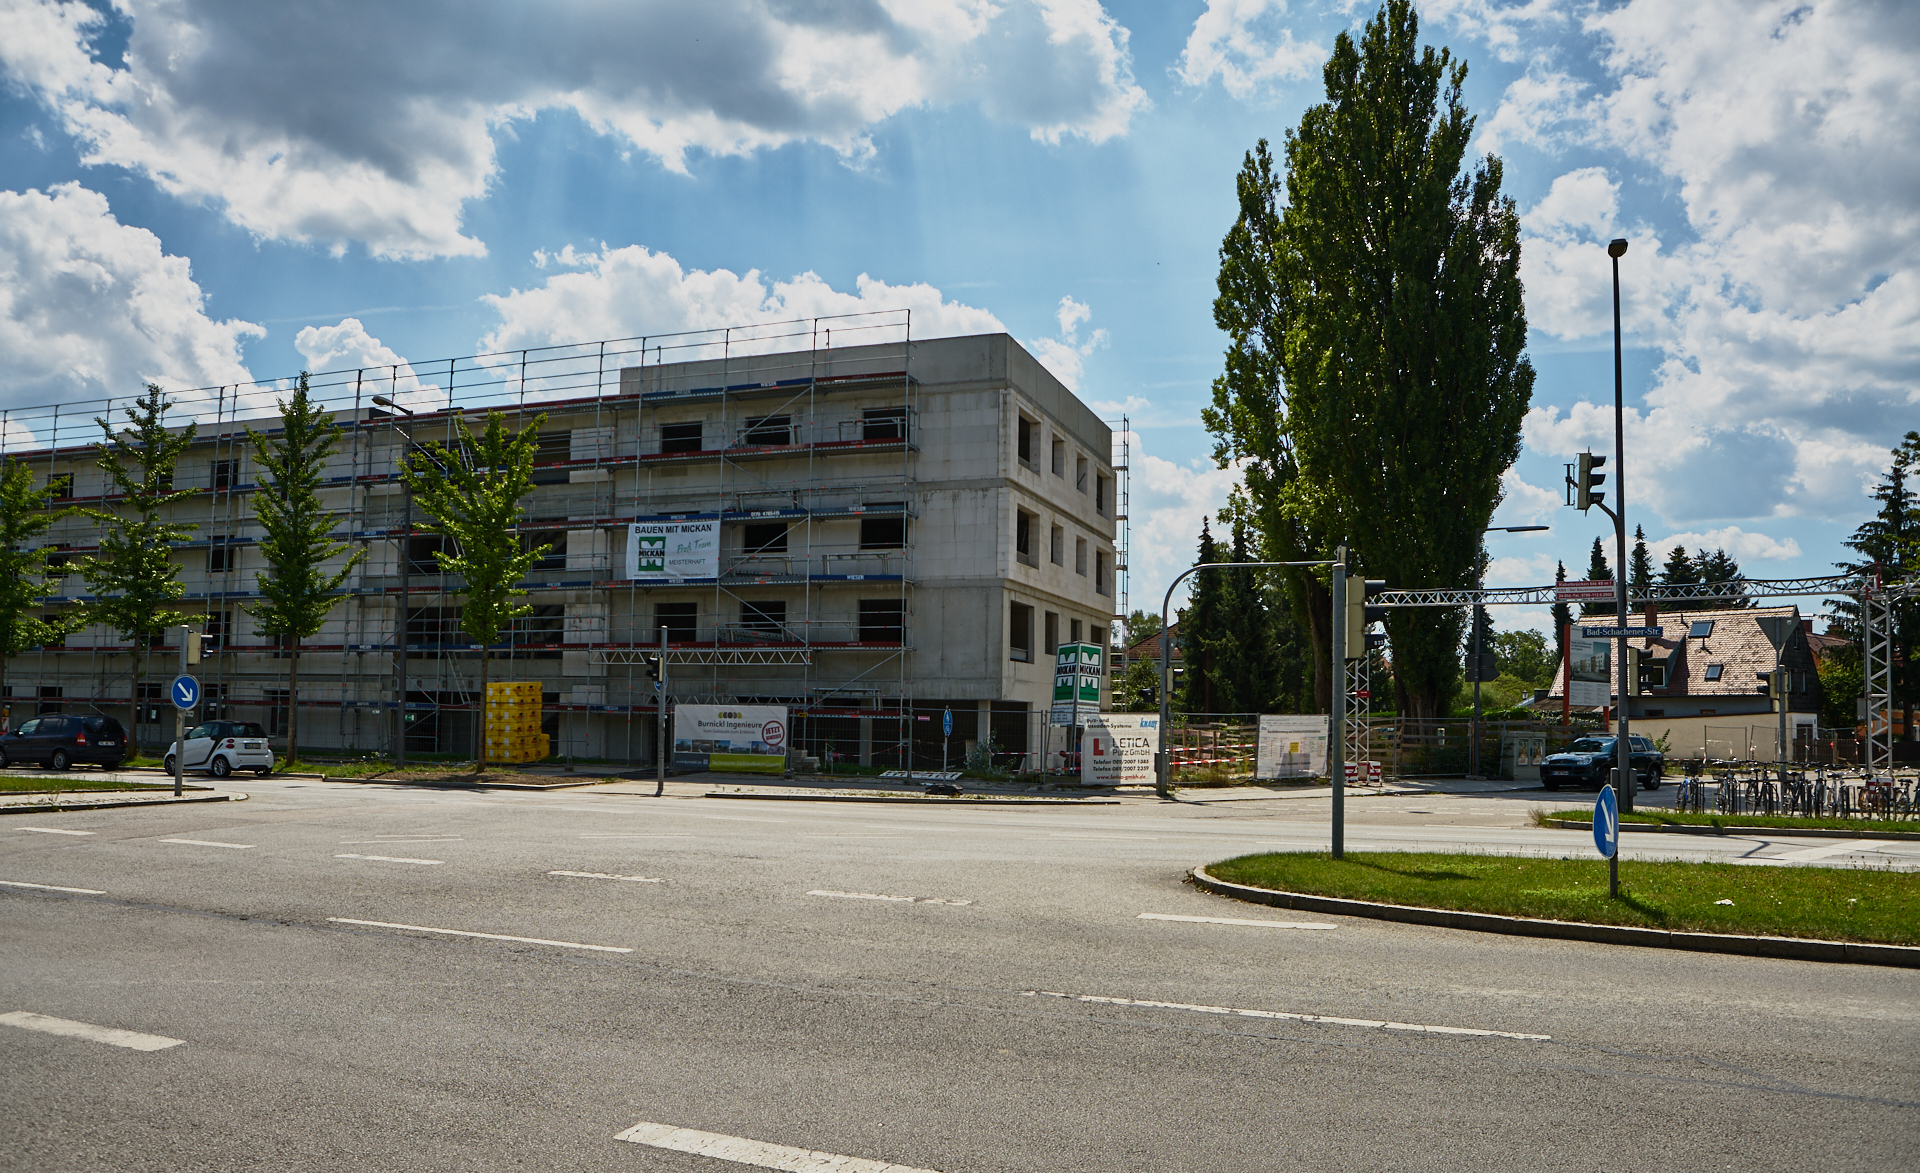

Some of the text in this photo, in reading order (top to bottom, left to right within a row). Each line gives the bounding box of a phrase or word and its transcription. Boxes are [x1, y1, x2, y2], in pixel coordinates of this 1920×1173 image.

[635, 524, 712, 534] BAUEN MIT MICKAN
[677, 538, 712, 554] Profi Team
[638, 549, 665, 557] MICKAN
[1586, 626, 1660, 636] Bad-Schachener-Str.
[1056, 664, 1077, 675] MICKAN
[1080, 664, 1101, 676] MICKAN
[698, 720, 763, 730] Burnickl Ingenieure
[765, 726, 780, 735] JETZT
[1112, 737, 1150, 748] LETICA
[1129, 748, 1150, 756] GmbH
